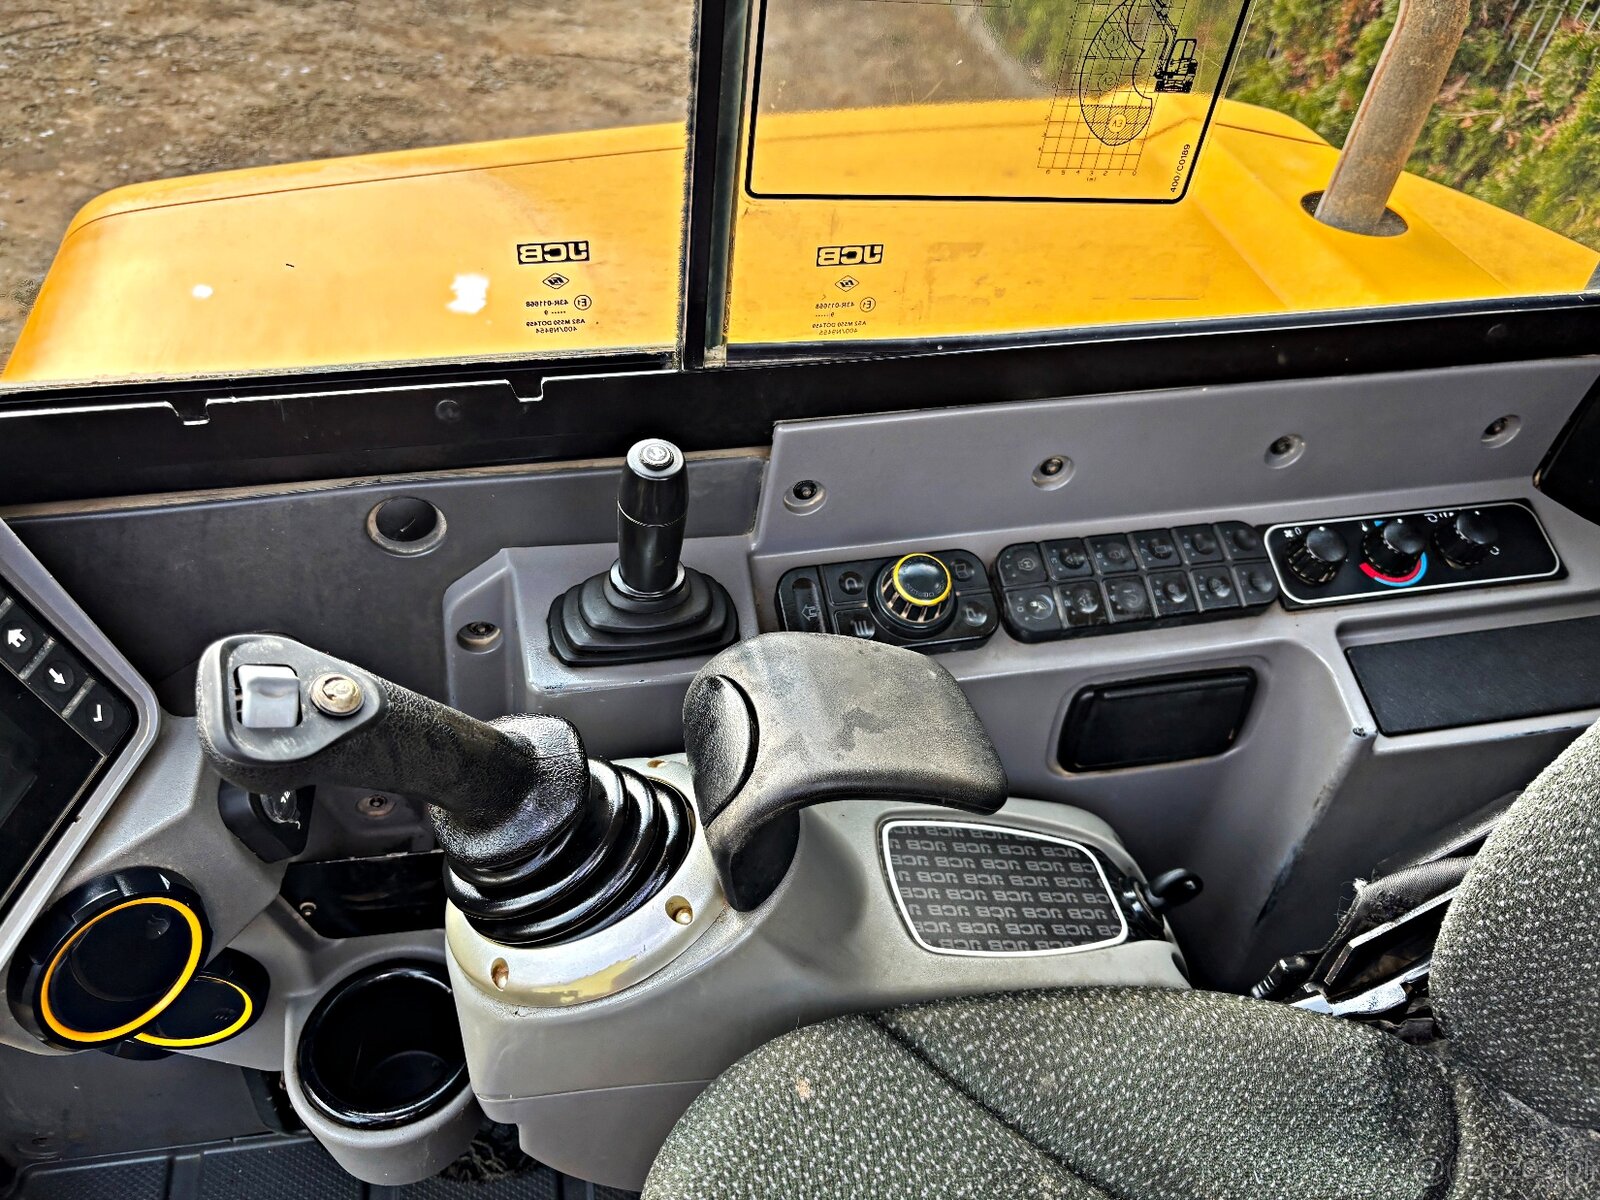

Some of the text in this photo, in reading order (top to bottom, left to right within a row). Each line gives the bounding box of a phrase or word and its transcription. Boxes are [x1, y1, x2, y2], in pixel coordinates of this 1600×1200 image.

[1170, 143, 1191, 193] 400/C0189
[906, 840, 947, 852] JCB
[952, 842, 993, 854] JCB
[997, 844, 1037, 856] JCB
[1041, 847, 1080, 858] JCB
[934, 856, 976, 869] JCB
[981, 859, 1021, 870] JCB
[1025, 860, 1065, 872] JCB
[916, 871, 959, 884] JCB
[963, 873, 1005, 885] JCB
[1008, 875, 1050, 887] JCB
[1053, 877, 1094, 888] JCB
[945, 888, 988, 901] JCB
[992, 890, 1034, 902] JCB
[1038, 892, 1079, 903] JCB
[927, 904, 970, 917] JCB
[974, 905, 1018, 918] JCB
[1022, 907, 1063, 919] JCB
[1067, 908, 1108, 920] JCB
[957, 922, 1000, 934] JCB
[1005, 923, 1047, 935] JCB
[1051, 924, 1093, 936] JCB
